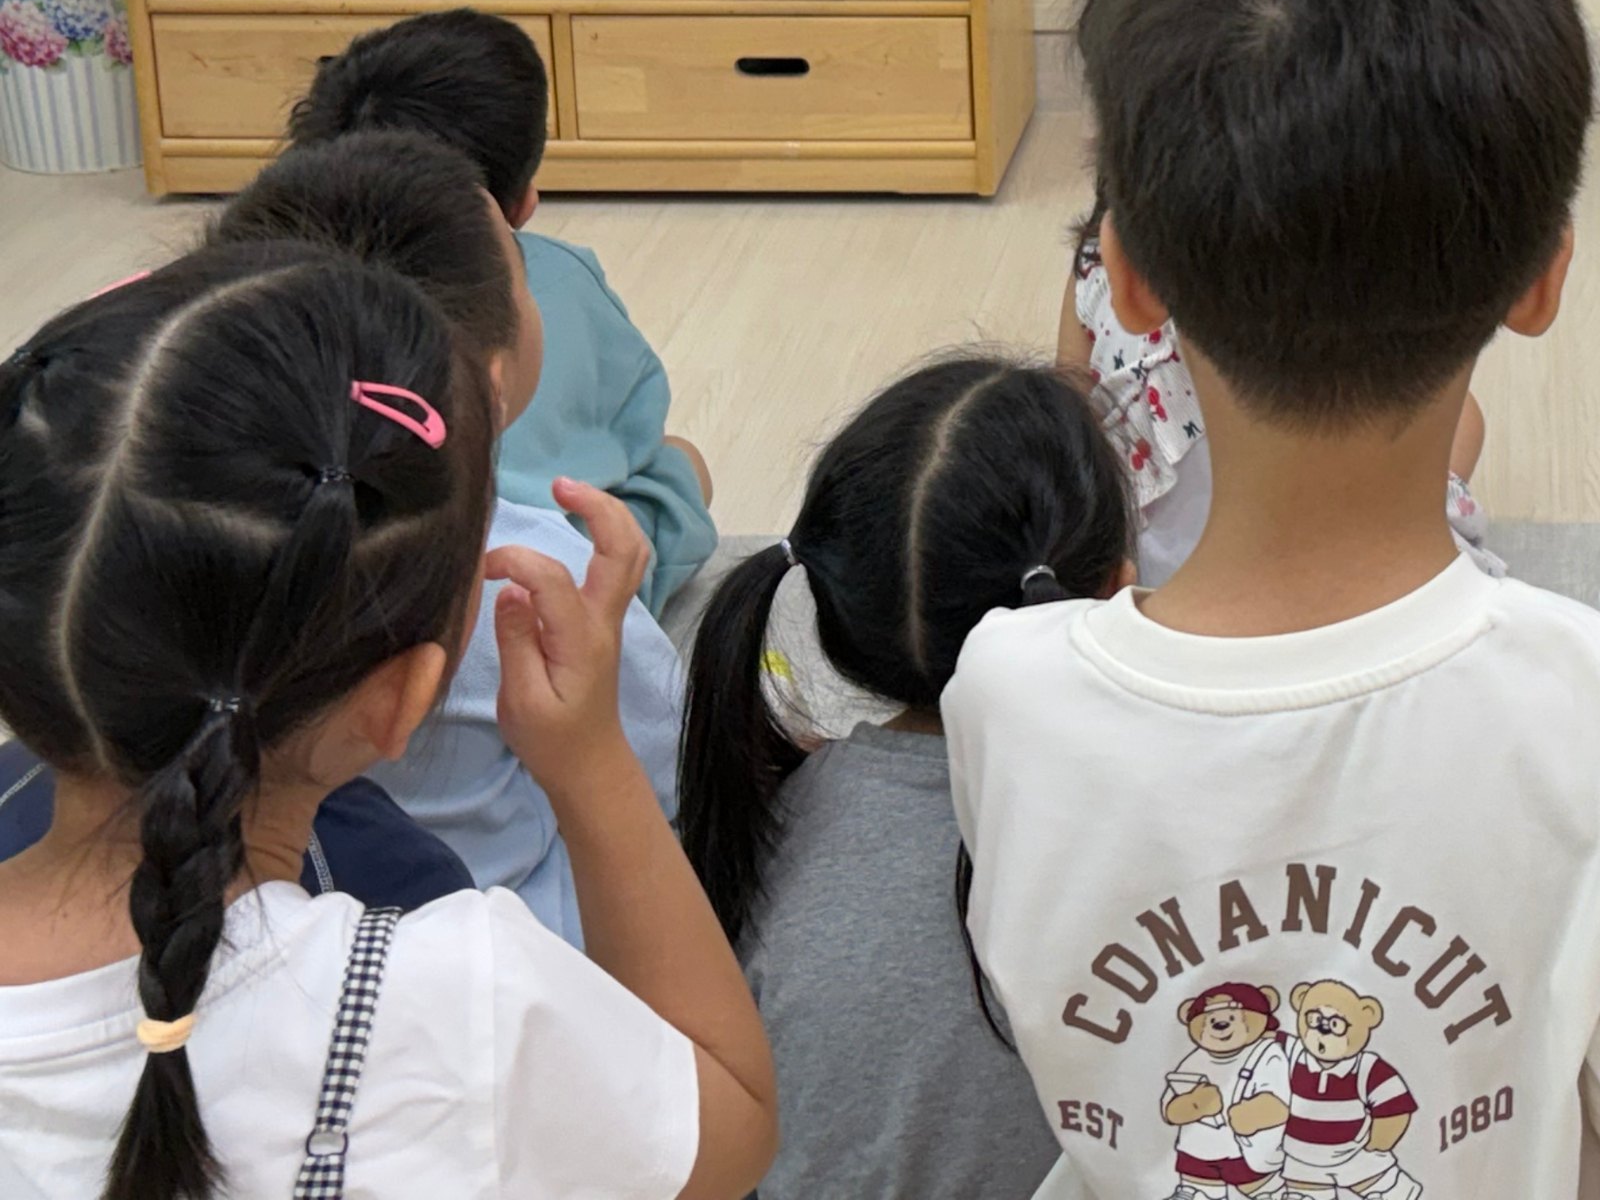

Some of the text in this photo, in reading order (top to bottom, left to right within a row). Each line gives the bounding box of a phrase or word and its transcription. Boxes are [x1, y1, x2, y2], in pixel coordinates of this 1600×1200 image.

[1061, 862, 1512, 1045] CONANICUT
[1057, 1085, 1515, 1153] EST 1980
